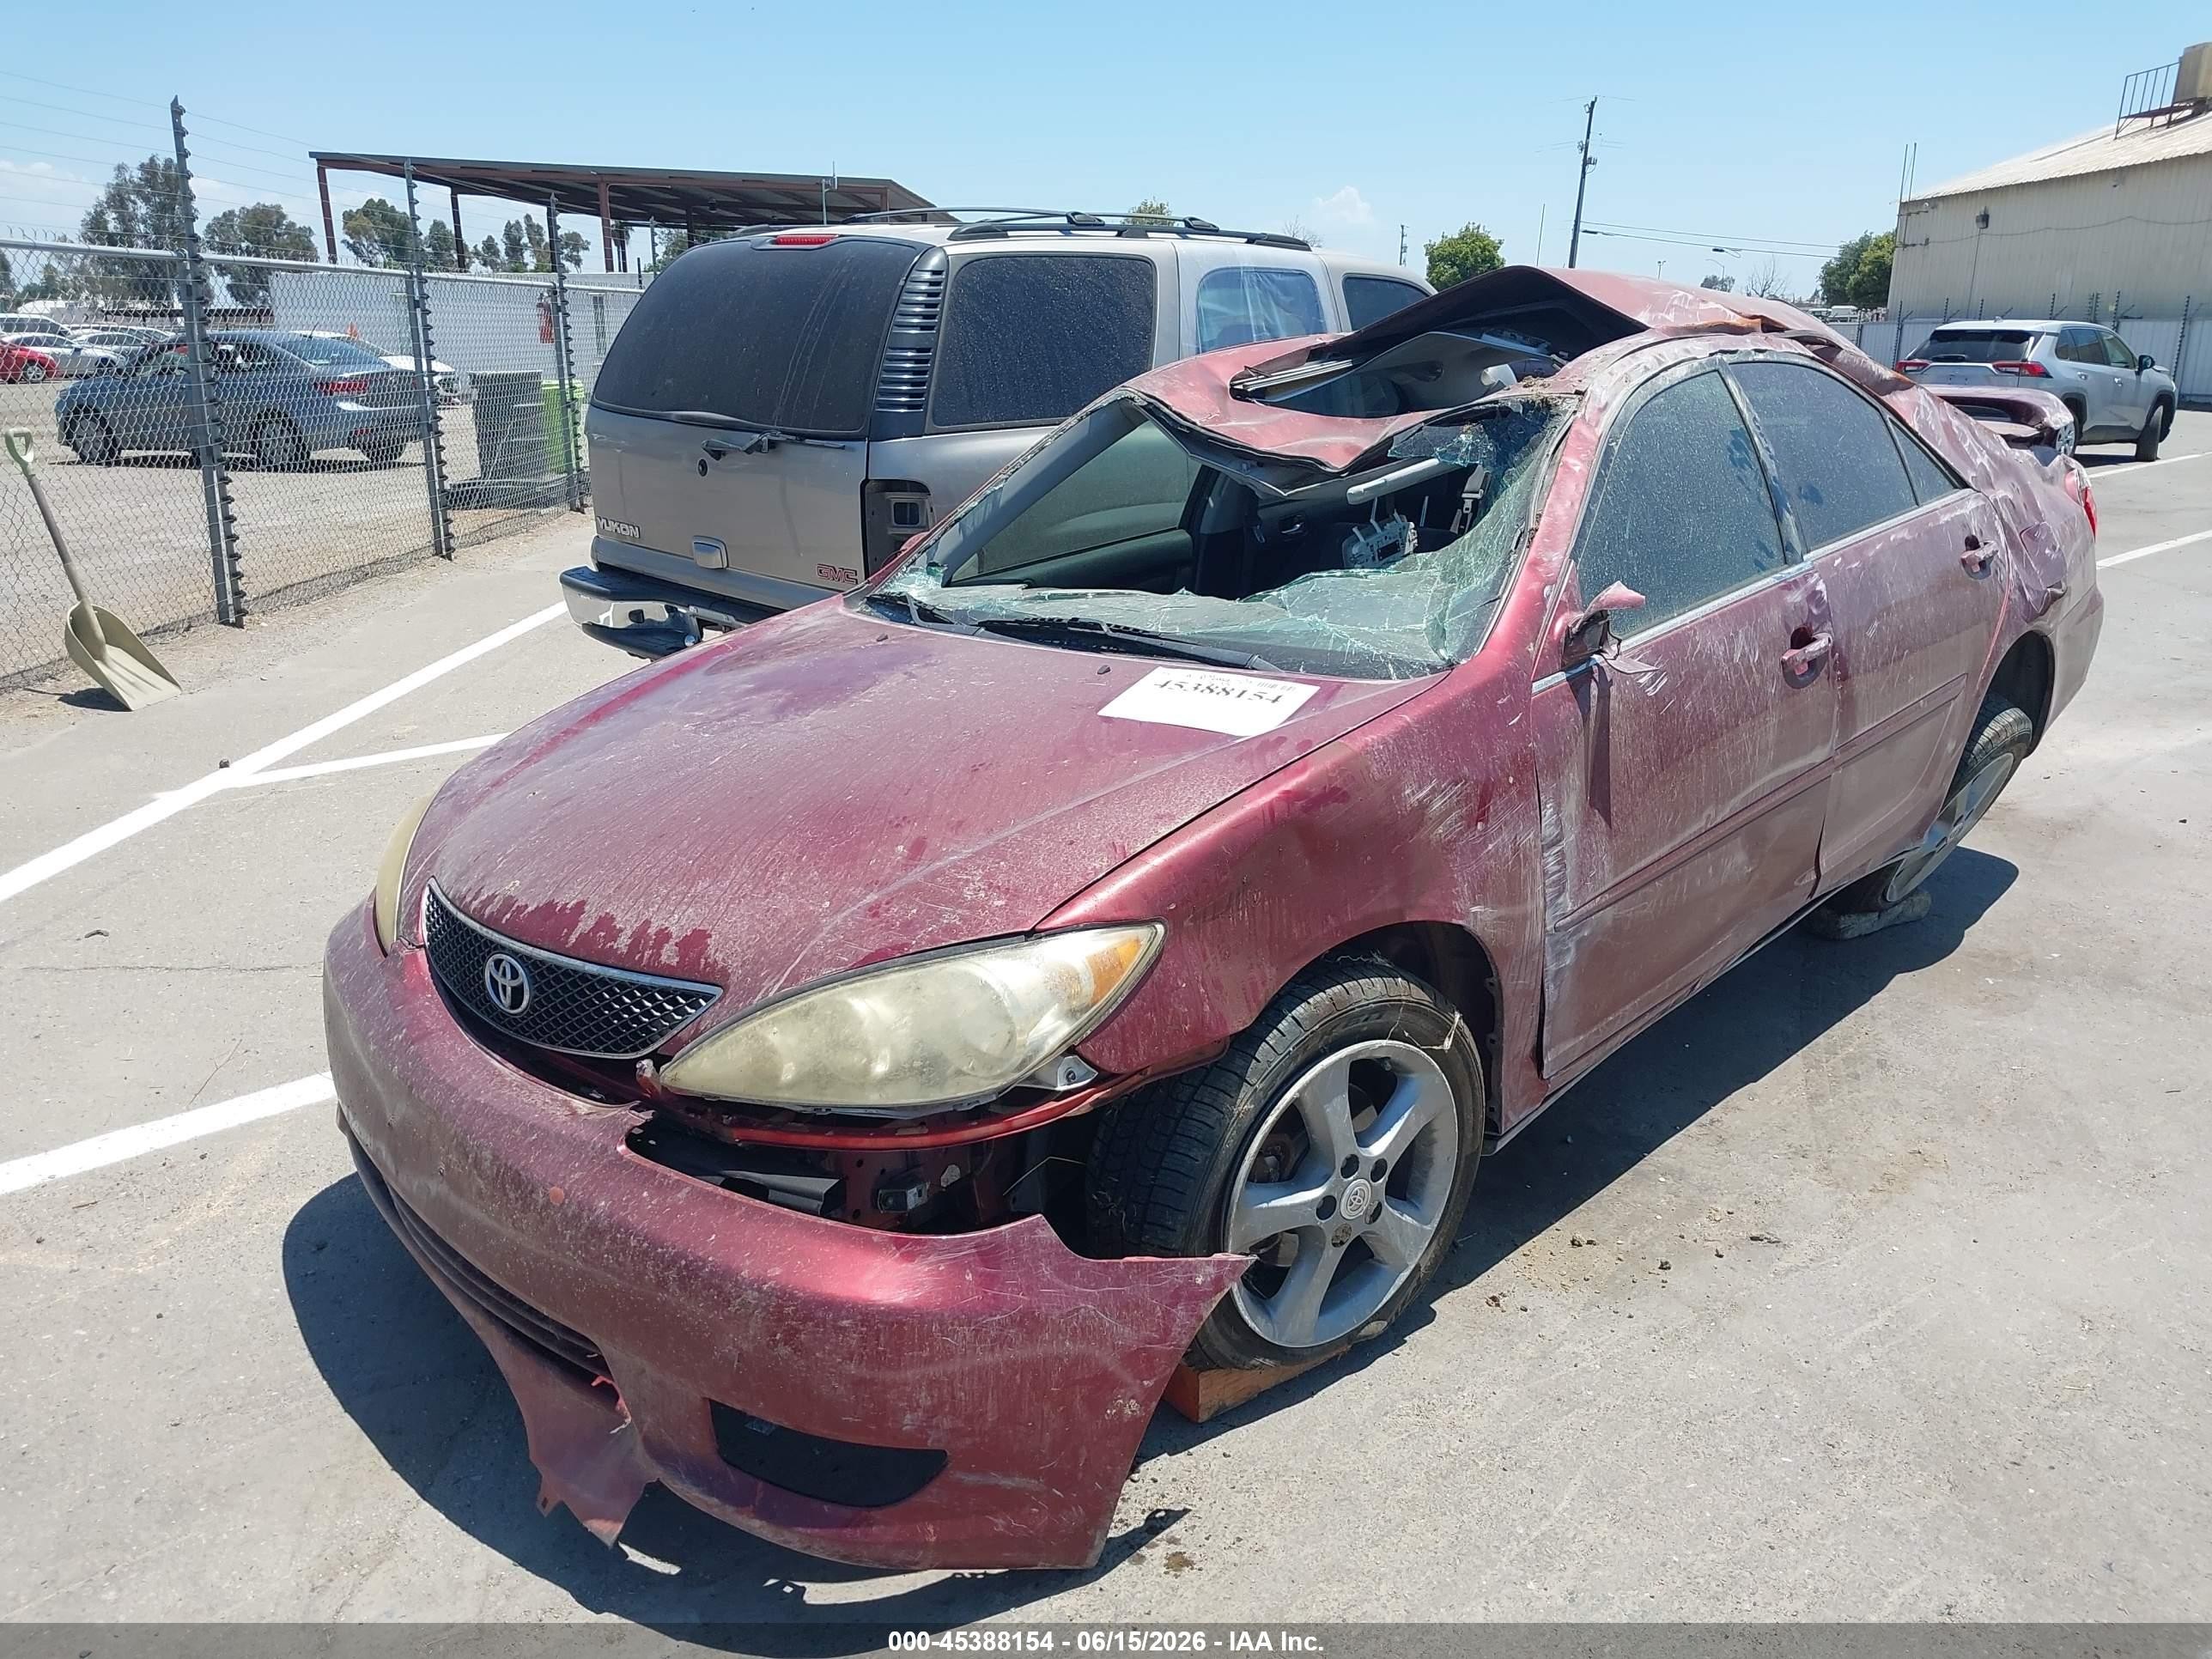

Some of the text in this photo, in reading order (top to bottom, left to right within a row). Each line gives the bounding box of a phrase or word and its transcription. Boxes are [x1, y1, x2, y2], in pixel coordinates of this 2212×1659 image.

[596, 516, 641, 538] YUKON
[817, 563, 858, 585] GMC
[1154, 679, 1284, 704] 45388154
